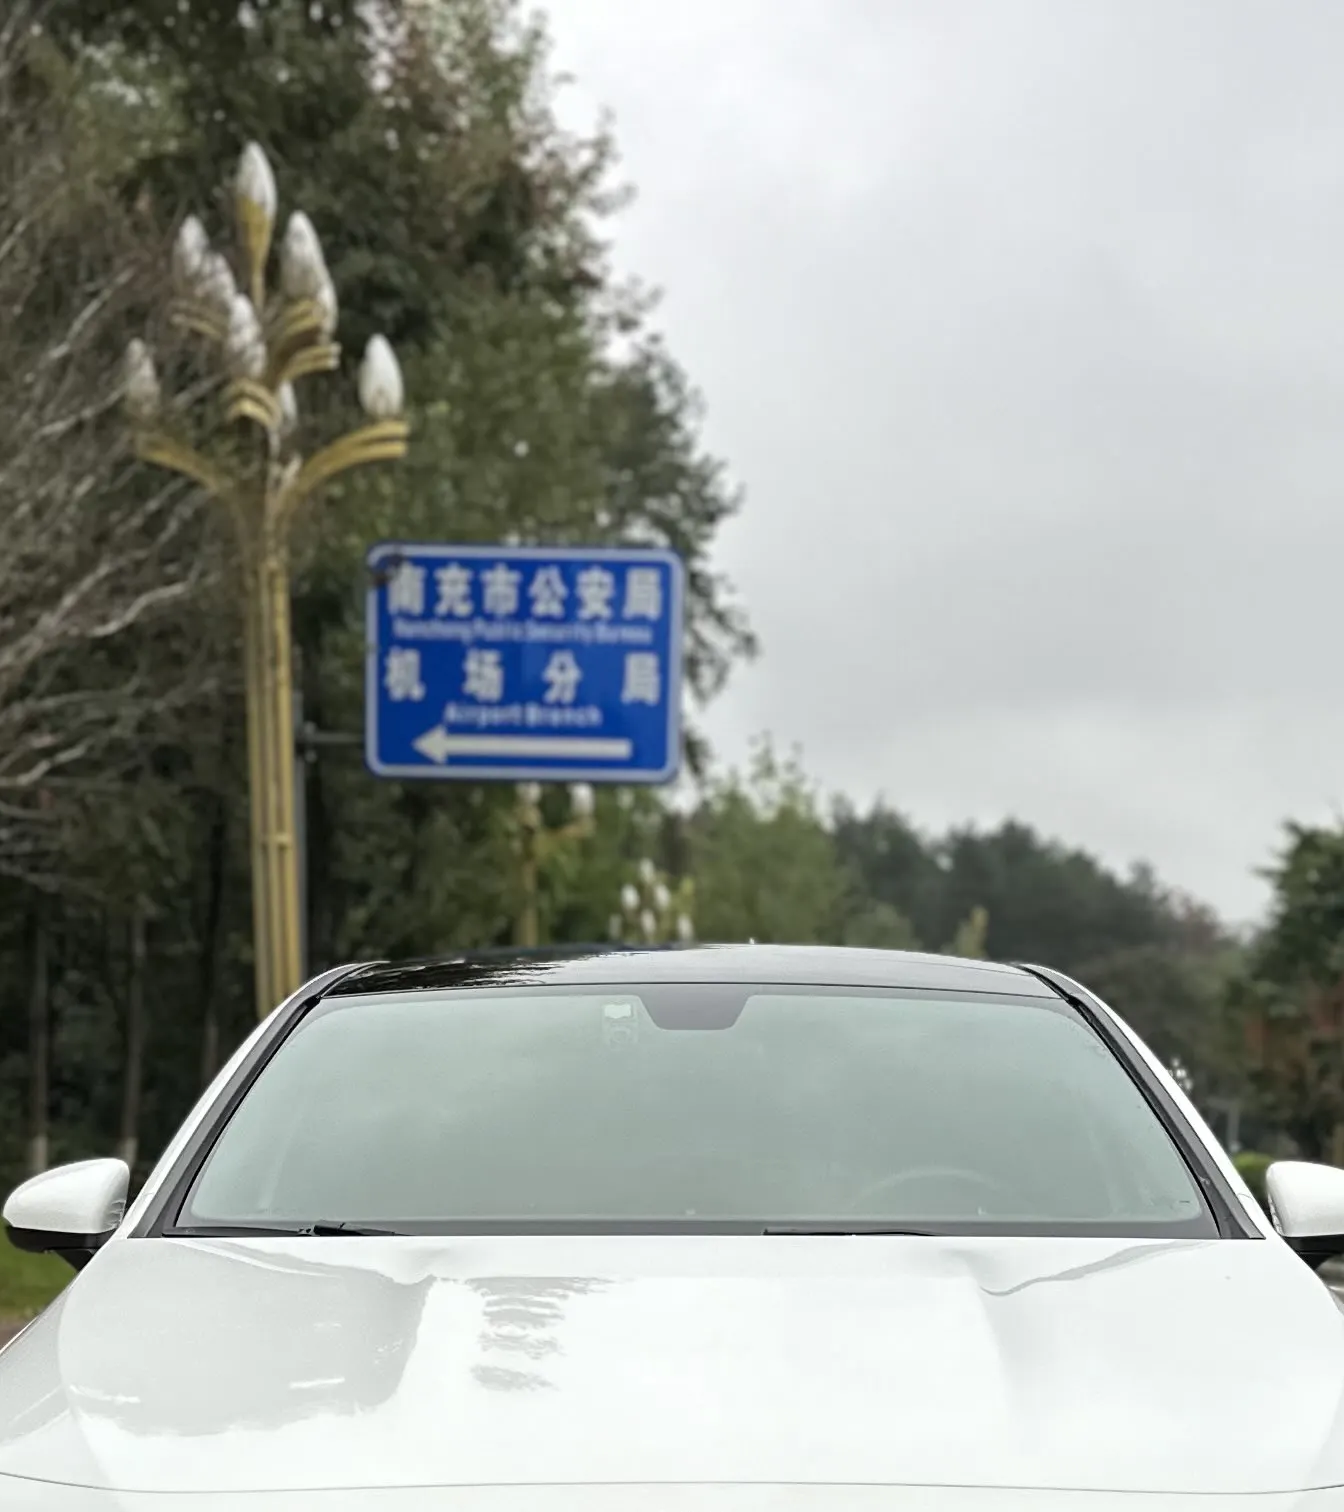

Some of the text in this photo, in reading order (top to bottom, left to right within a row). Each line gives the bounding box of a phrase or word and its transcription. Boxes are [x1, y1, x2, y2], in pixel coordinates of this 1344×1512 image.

[387, 562, 661, 621] 南充市公安局
[384, 646, 660, 706] 机场分局
[444, 702, 603, 729] Airport Branch
